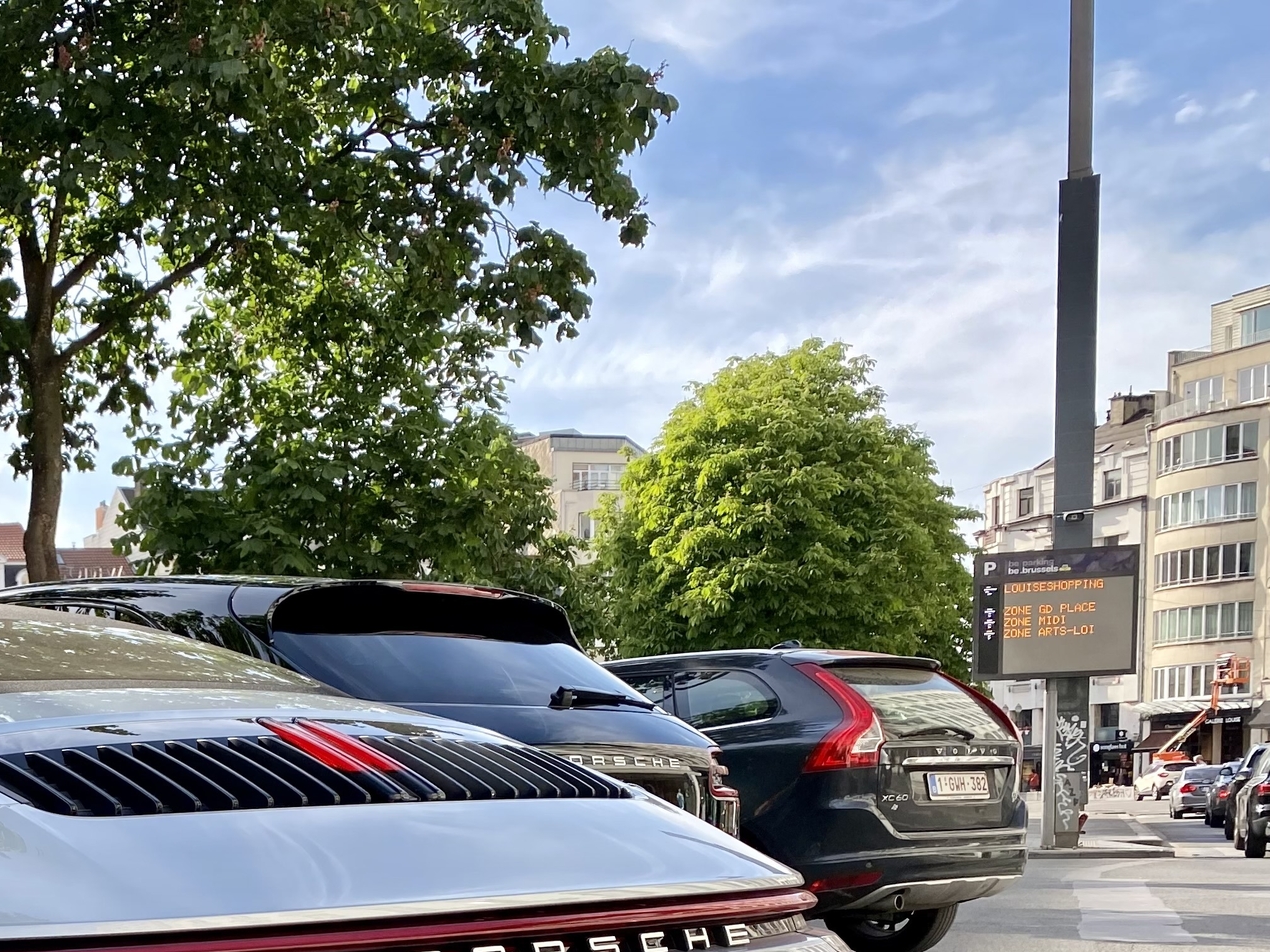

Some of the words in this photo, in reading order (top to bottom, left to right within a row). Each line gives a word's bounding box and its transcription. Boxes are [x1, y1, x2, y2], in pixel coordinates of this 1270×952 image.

[983, 561, 997, 576] P
[1022, 557, 1055, 568] parking
[1004, 578, 1104, 594] LOUISESHOPPING
[1004, 605, 1032, 616] ZONE
[1038, 604, 1053, 614] GD
[1060, 601, 1096, 613] PLACE
[1004, 617, 1032, 627] ZONE
[1038, 614, 1066, 626] MIDI
[1004, 628, 1032, 639] ZONE
[1038, 624, 1095, 637] ARTS-LOI
[568, 755, 681, 768] ORSCHE
